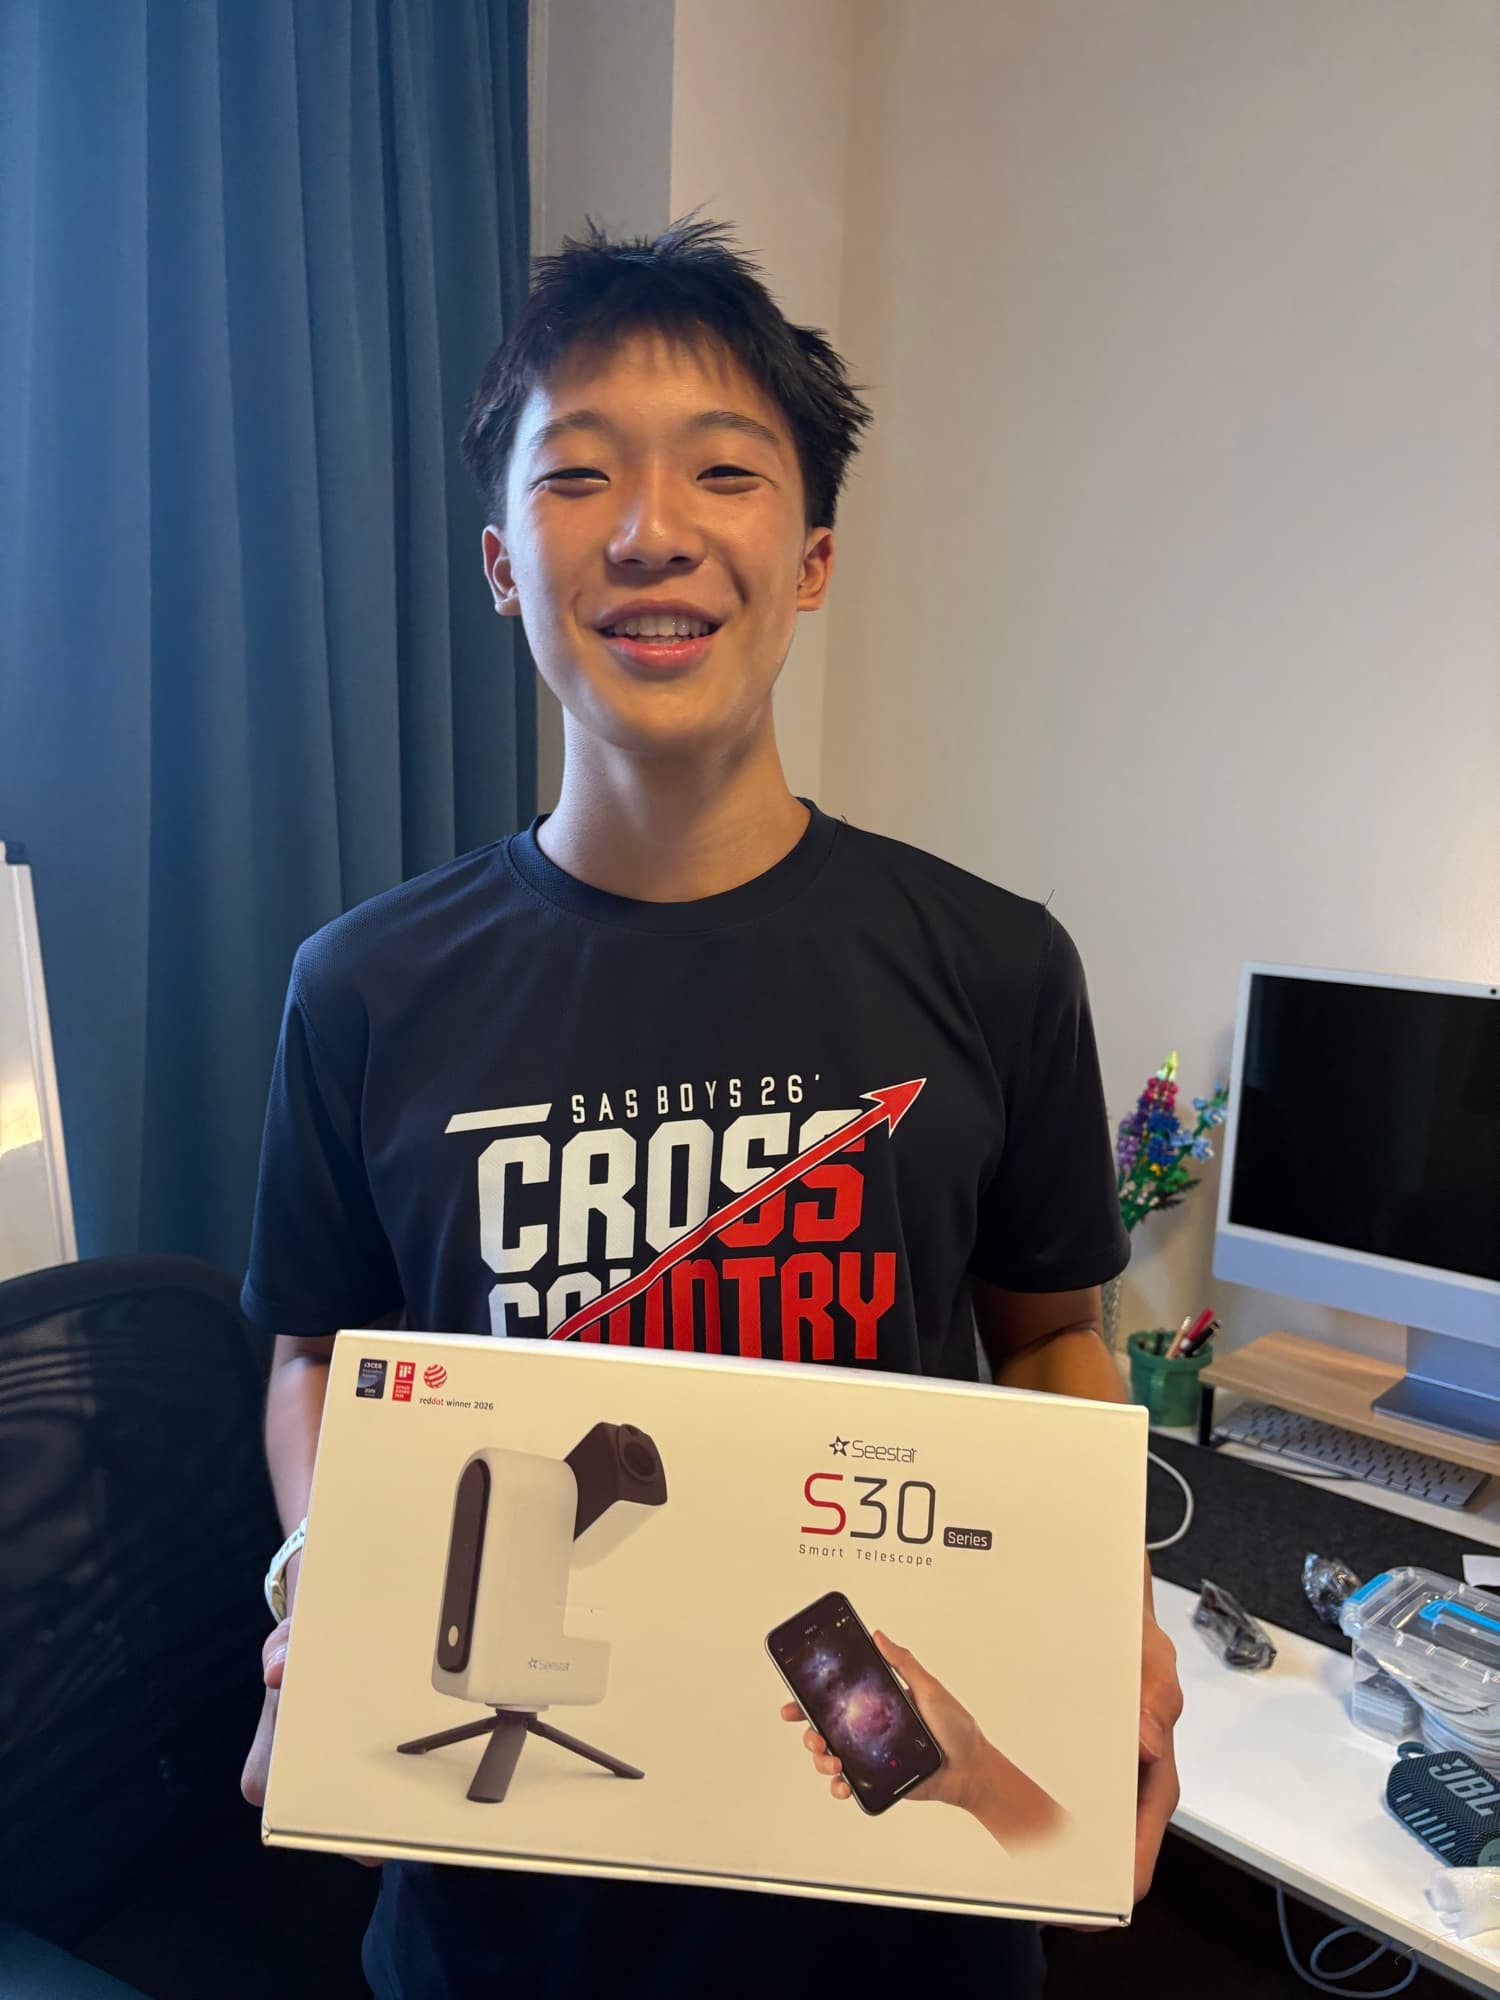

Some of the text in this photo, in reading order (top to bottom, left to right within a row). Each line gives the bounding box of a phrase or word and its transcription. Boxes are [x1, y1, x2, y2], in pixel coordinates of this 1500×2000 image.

[571, 1089, 638, 1124] SAS
[657, 1079, 742, 1115] BOYS
[477, 1108, 865, 1274] CROSS
[446, 1399, 472, 1409] winner
[474, 1401, 494, 1410] 2026
[851, 1439, 917, 1464] Seestar
[800, 1472, 988, 1547] S30 Series
[799, 1544, 933, 1566] Smart Telescope
[1428, 1758, 1500, 1817] JBL
